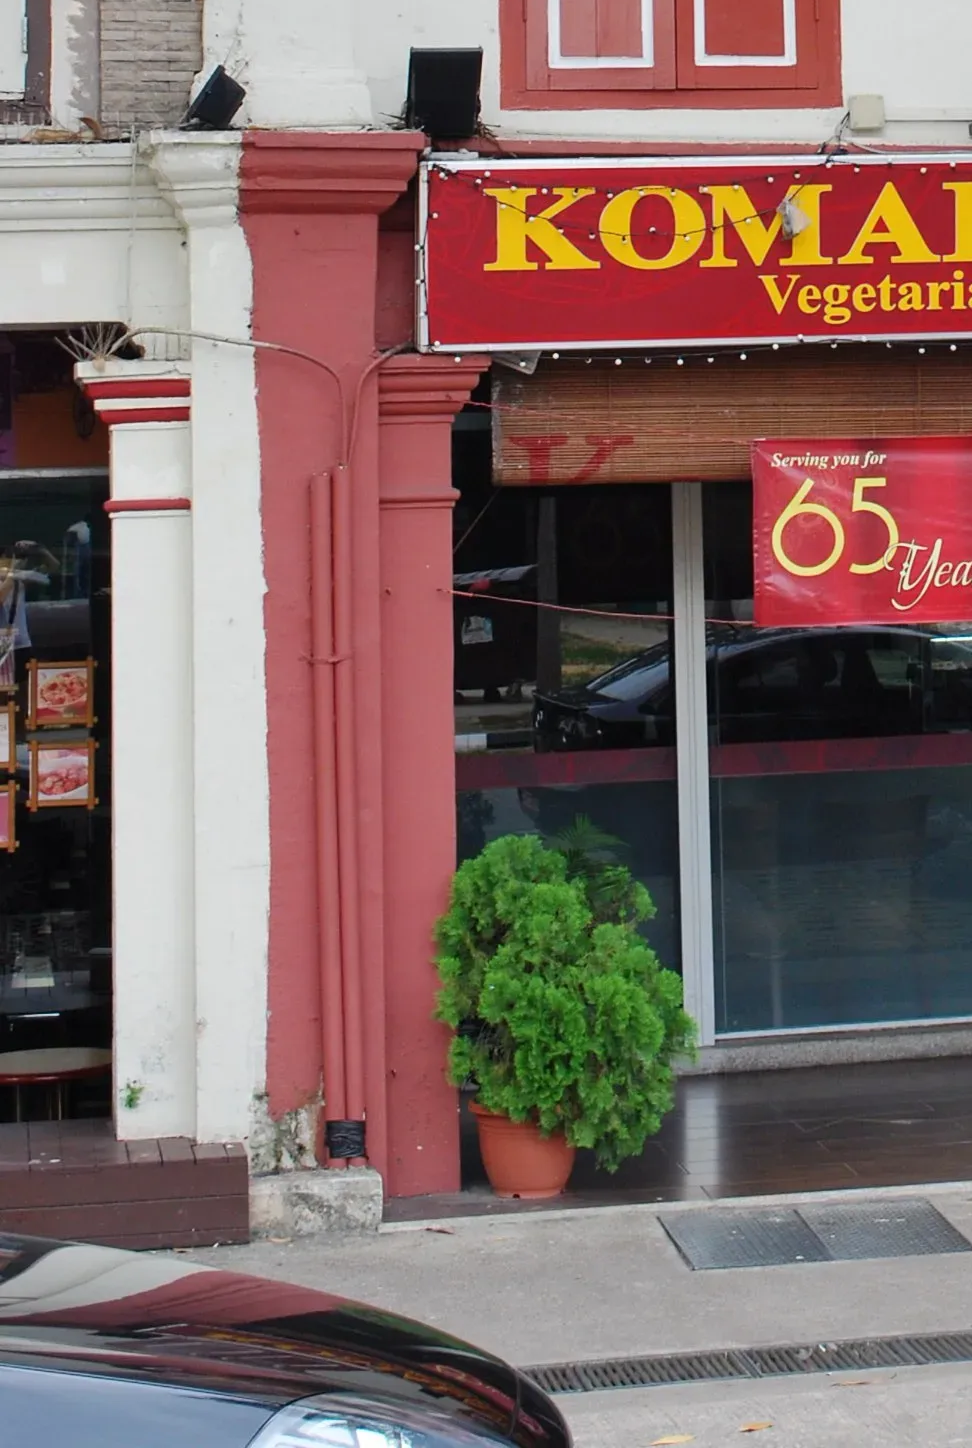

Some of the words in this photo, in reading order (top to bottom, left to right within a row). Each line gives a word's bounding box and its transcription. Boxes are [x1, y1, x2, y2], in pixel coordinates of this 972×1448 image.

[770, 452, 829, 470] Serving
[831, 454, 859, 470] you
[861, 450, 887, 469] for
[771, 476, 900, 578] 65
